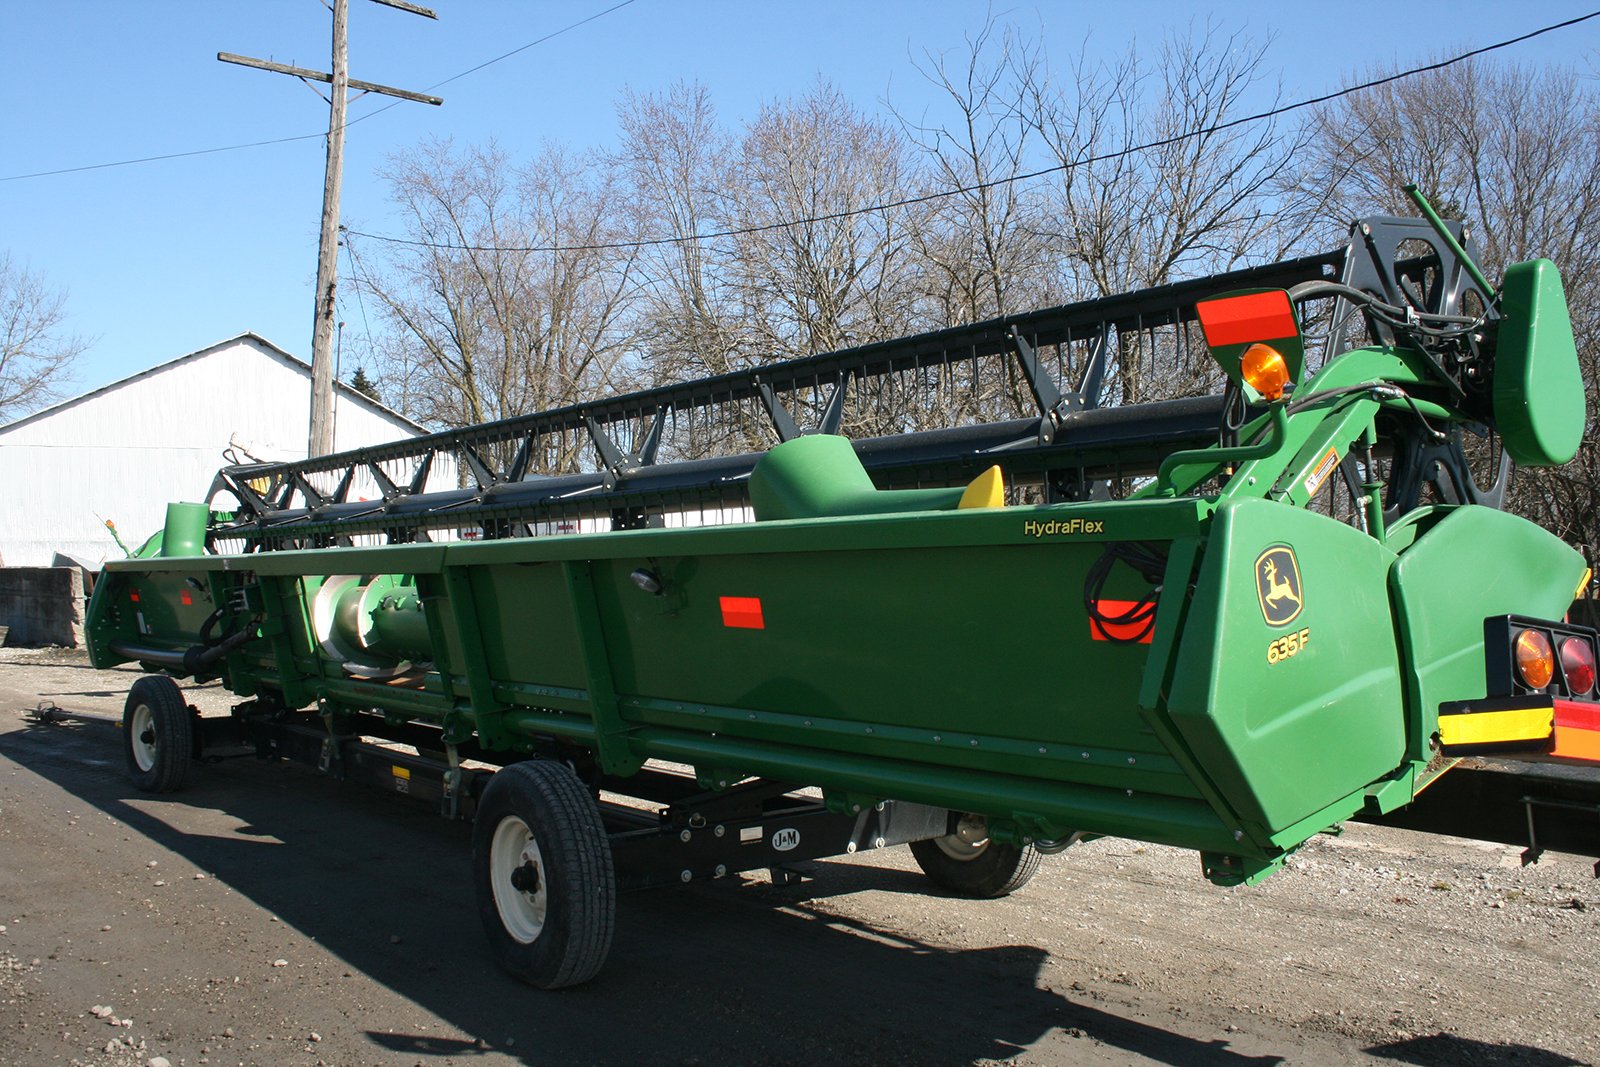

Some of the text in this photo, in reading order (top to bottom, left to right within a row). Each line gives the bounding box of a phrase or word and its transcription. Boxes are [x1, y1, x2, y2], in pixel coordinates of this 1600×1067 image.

[1024, 519, 1103, 537] HydraFlex
[1267, 627, 1310, 665] 635F
[774, 831, 796, 847] J&M
